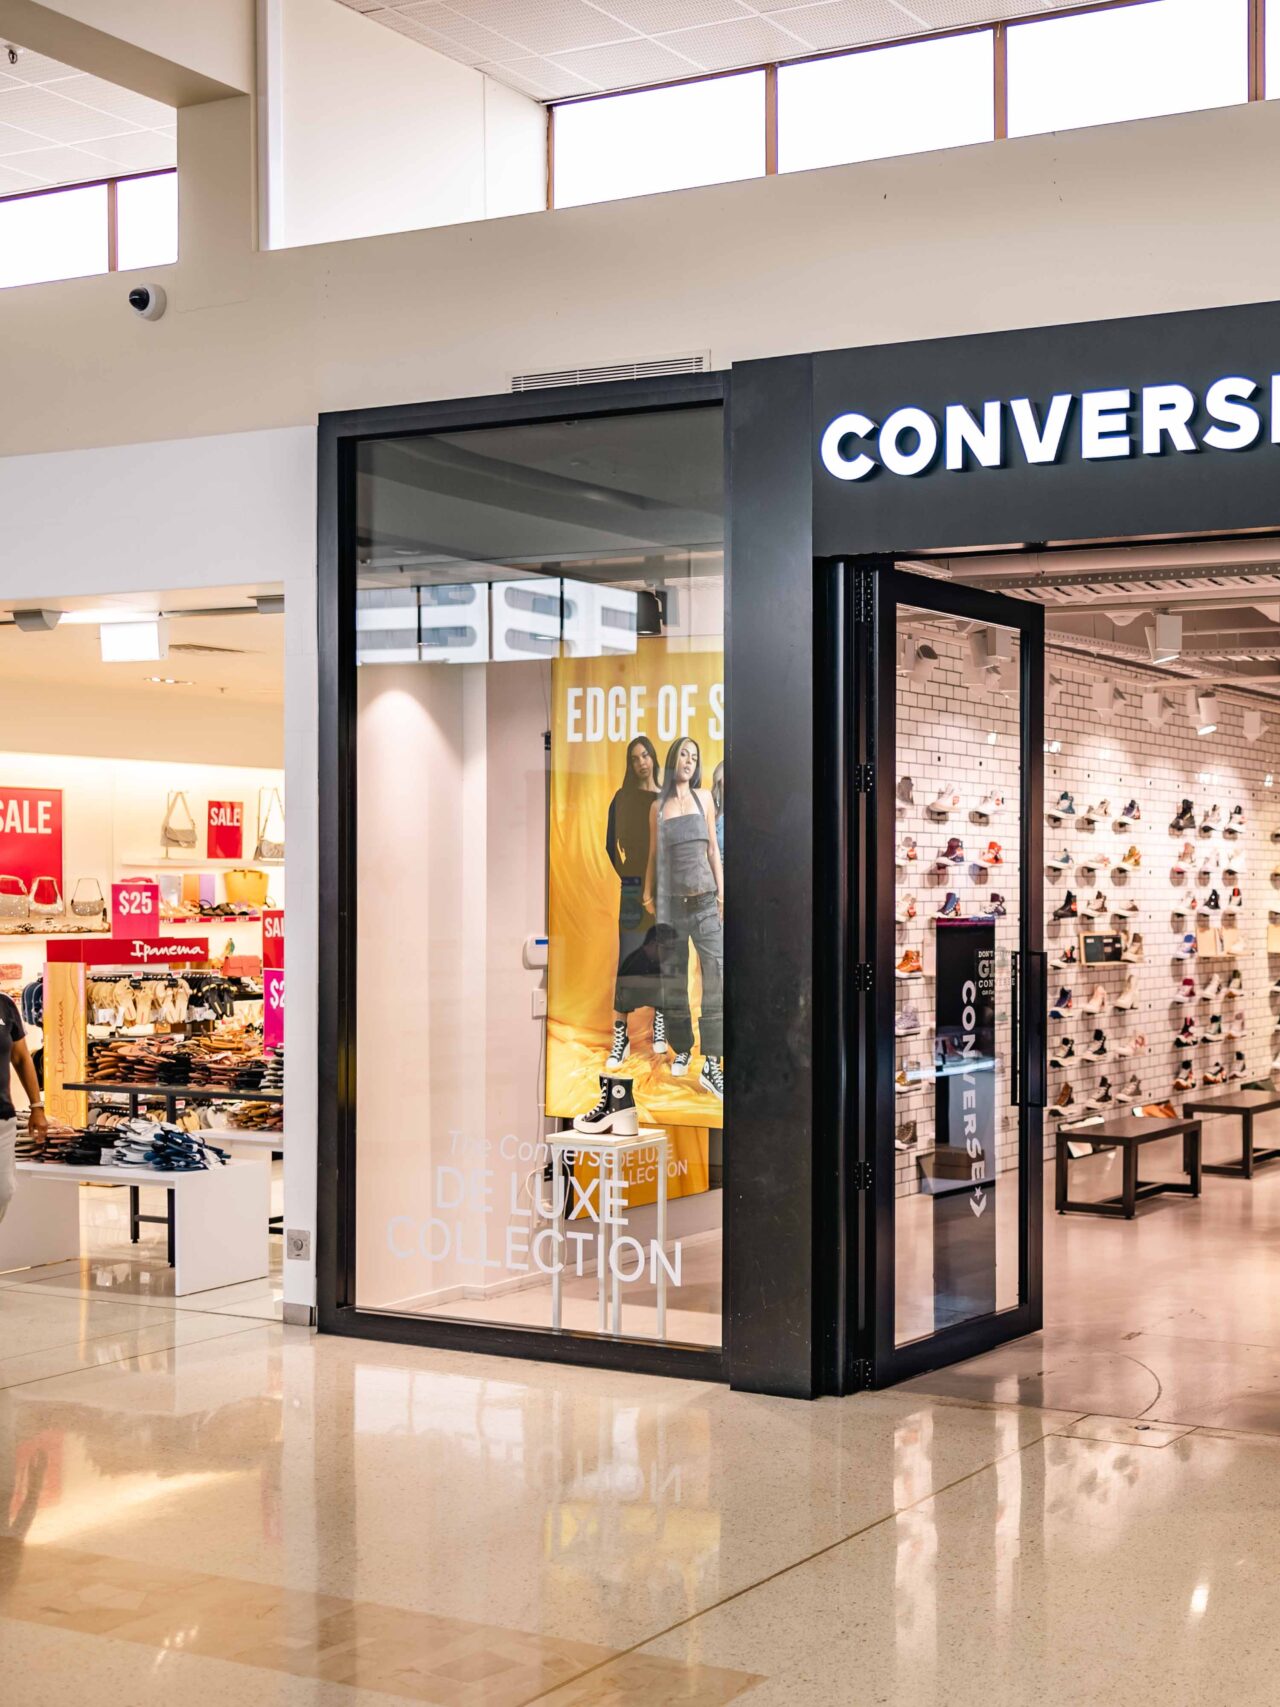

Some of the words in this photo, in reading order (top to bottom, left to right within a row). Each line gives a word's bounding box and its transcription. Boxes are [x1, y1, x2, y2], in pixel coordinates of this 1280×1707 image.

[566, 686, 646, 742] EDGE
[657, 684, 698, 742] OF
[0, 799, 52, 835] ALE
[210, 807, 241, 827] SALE
[118, 891, 152, 916] $25
[130, 940, 206, 962] Ipanema
[500, 1134, 617, 1169] Converse
[436, 1165, 494, 1214] DE
[511, 1171, 630, 1227] LUXE
[385, 1215, 683, 1288] COLLECTION
